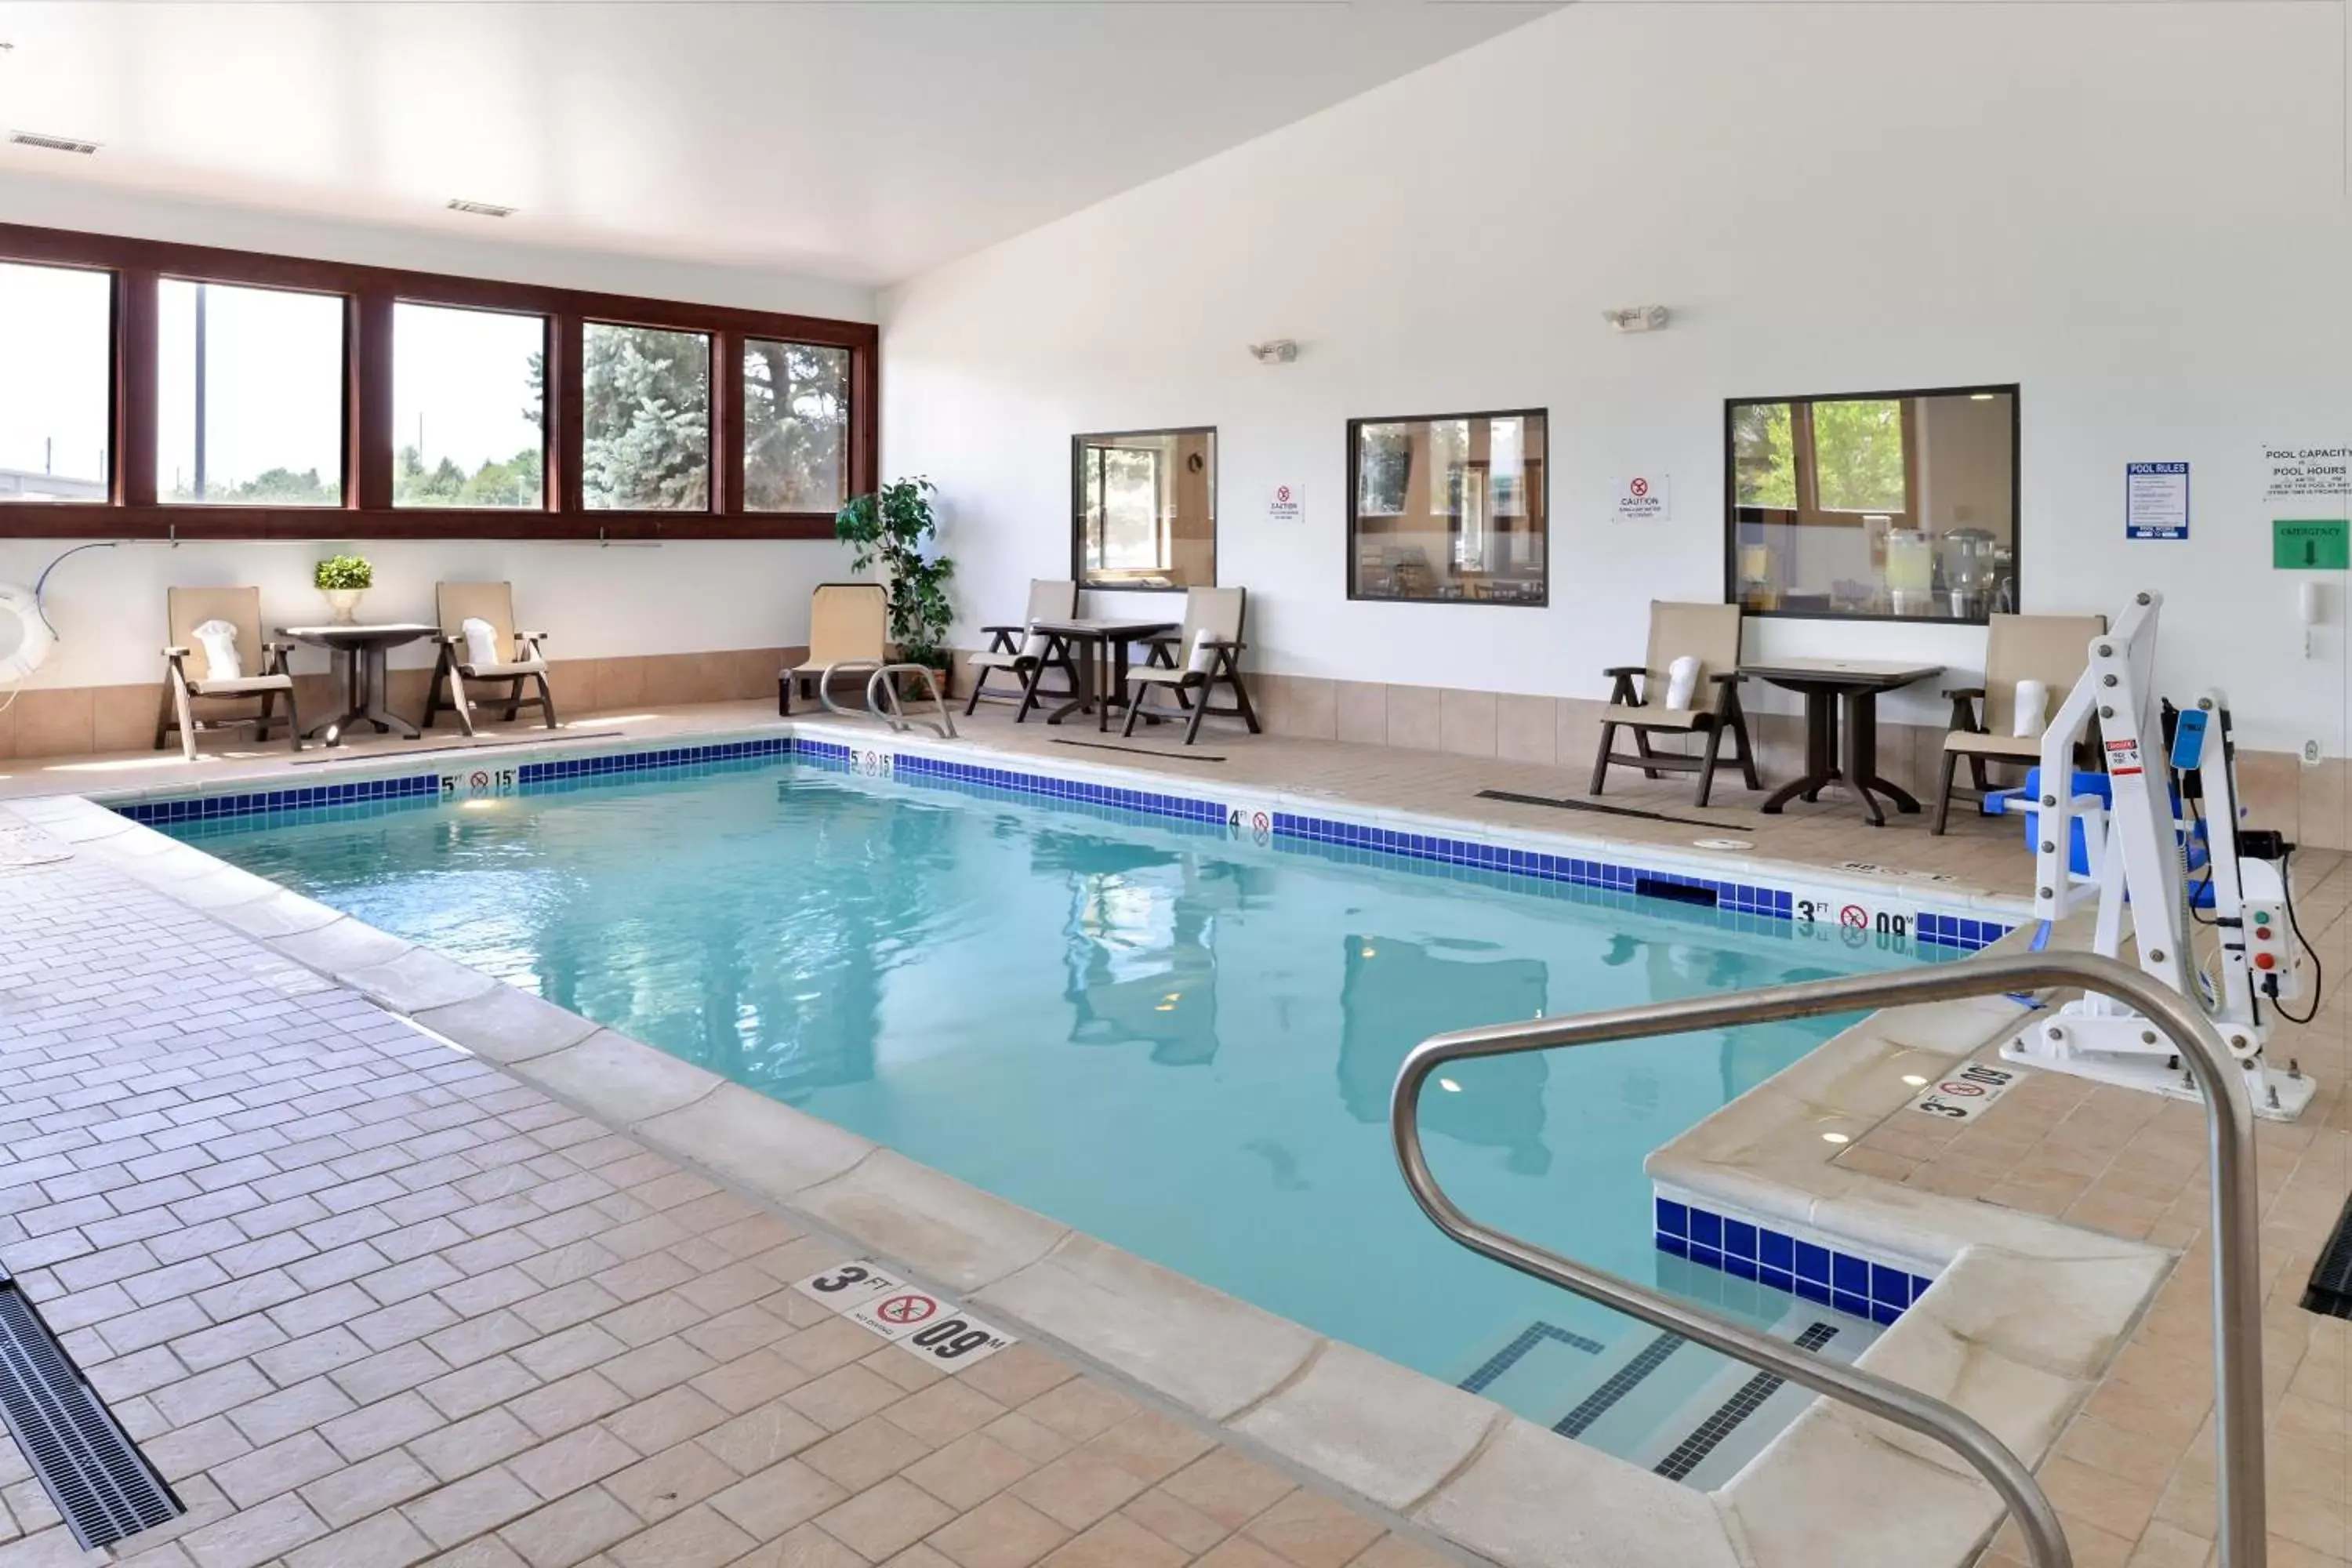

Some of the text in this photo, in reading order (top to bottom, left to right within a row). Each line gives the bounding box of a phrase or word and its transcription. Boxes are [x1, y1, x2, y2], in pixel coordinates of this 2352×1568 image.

[2131, 464, 2154, 473] POOL
[2274, 467, 2303, 476] POOL
[1229, 810, 1240, 826] 4
[1817, 902, 1829, 913] FT
[812, 1266, 869, 1292] 3
